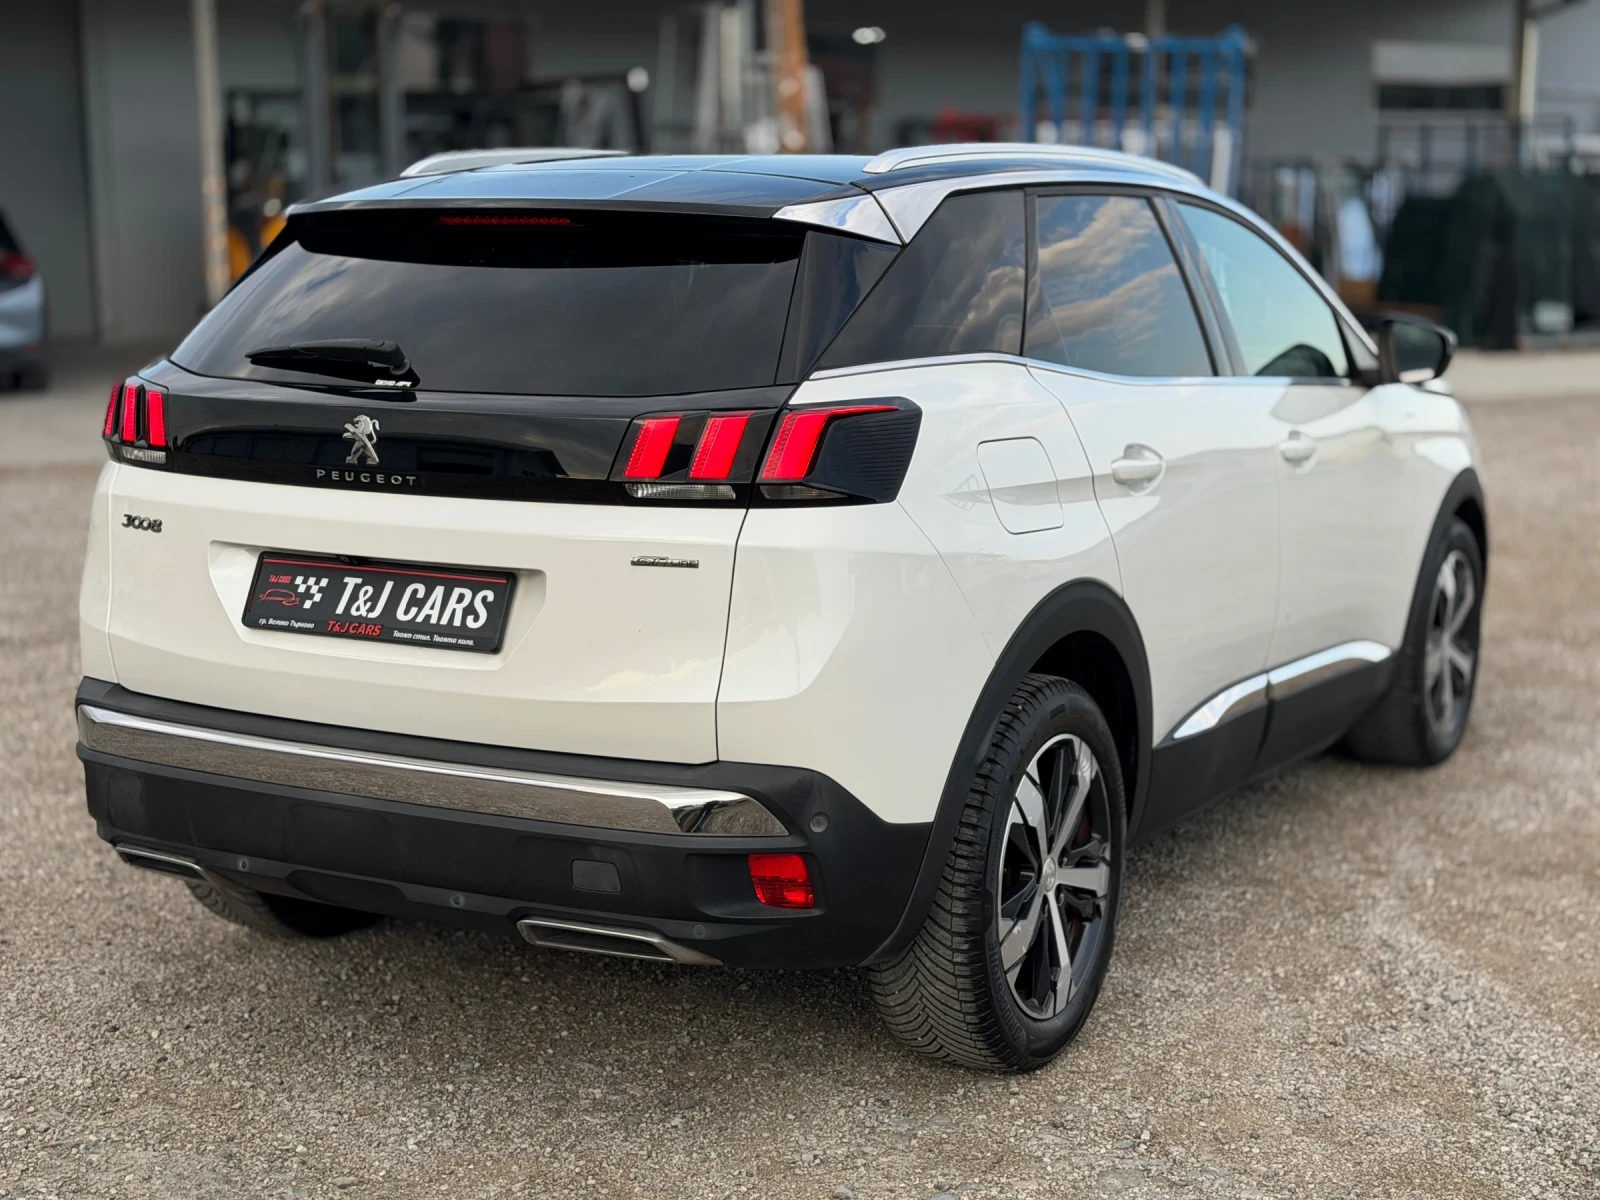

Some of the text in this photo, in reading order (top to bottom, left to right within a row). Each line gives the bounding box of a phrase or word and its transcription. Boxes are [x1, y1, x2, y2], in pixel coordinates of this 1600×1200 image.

[316, 469, 416, 486] PEUGEOT
[121, 513, 163, 533] 3008
[335, 576, 495, 629] T&J CARS
[327, 620, 383, 637] T&J CARS
